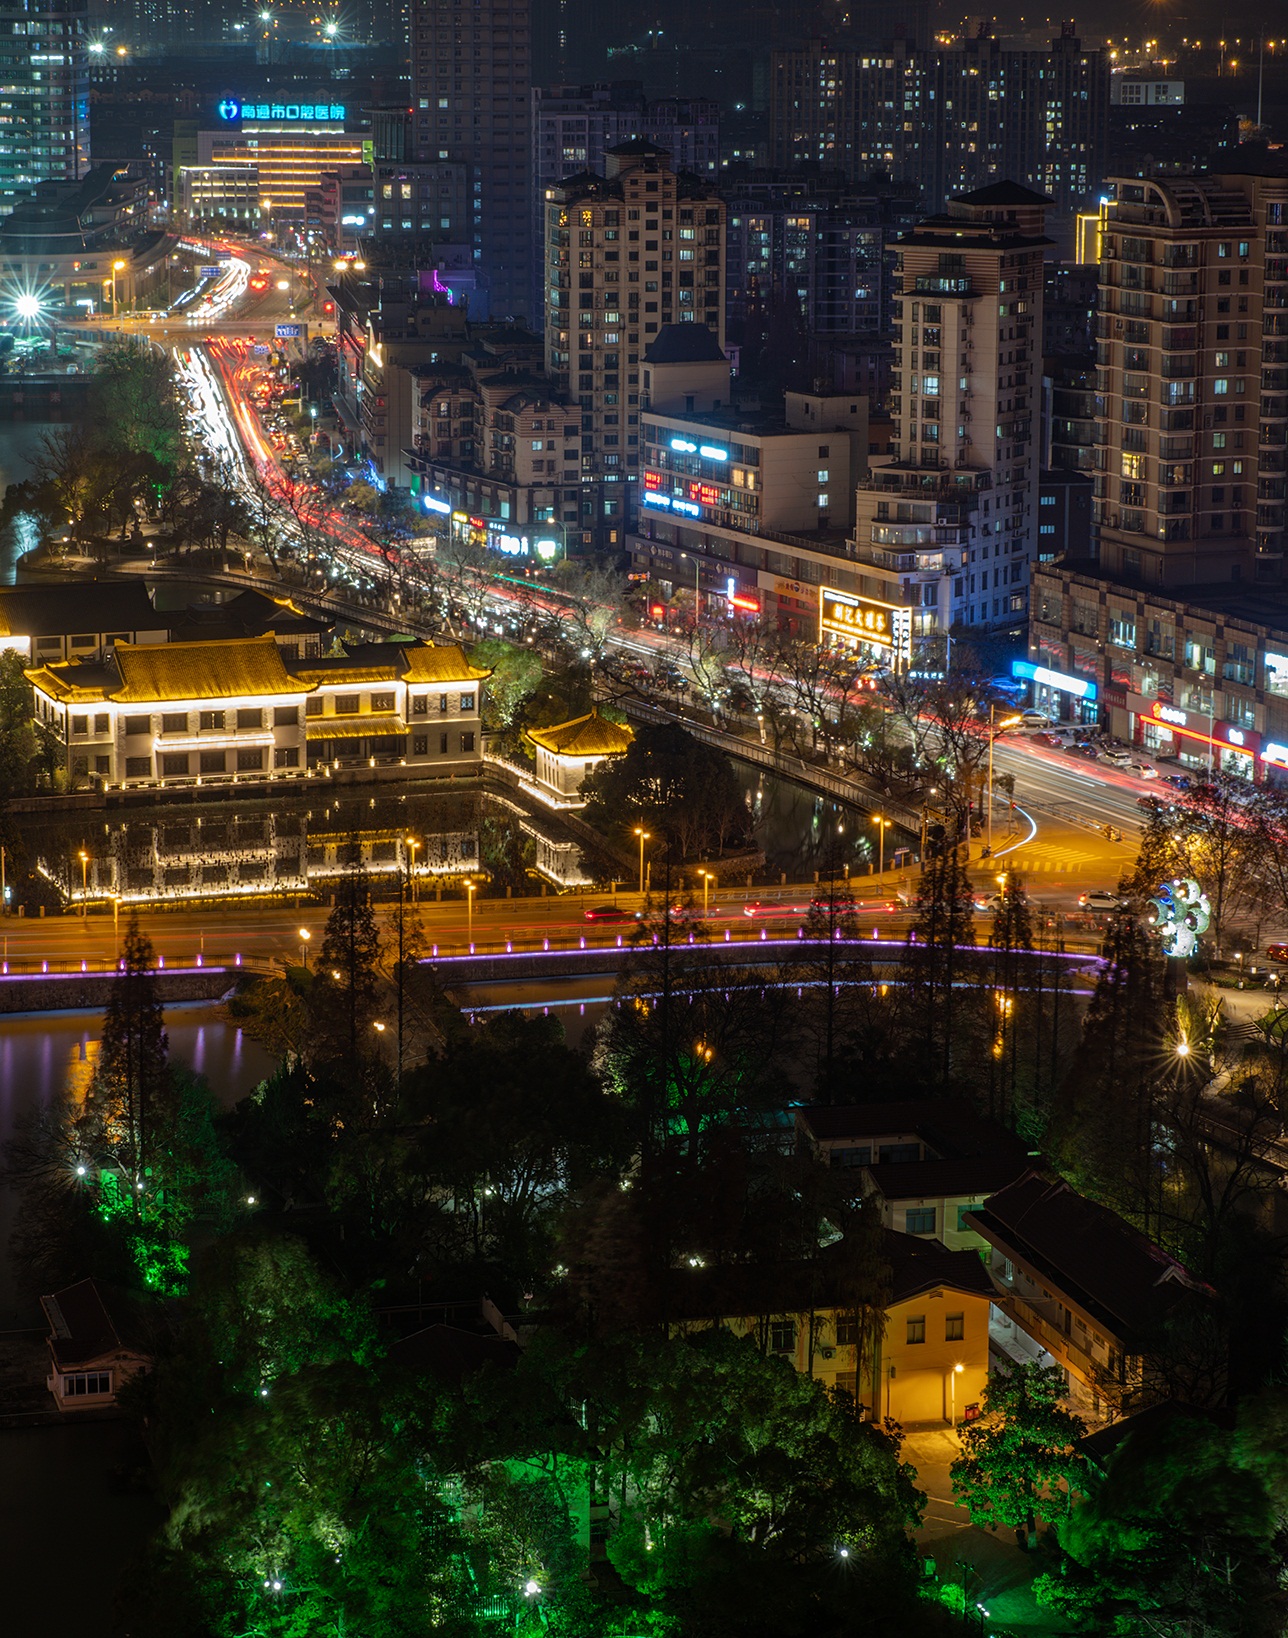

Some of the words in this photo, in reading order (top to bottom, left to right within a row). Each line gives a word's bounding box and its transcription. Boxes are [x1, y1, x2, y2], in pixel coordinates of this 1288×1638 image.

[241, 105, 345, 120] 南通市口腔医院
